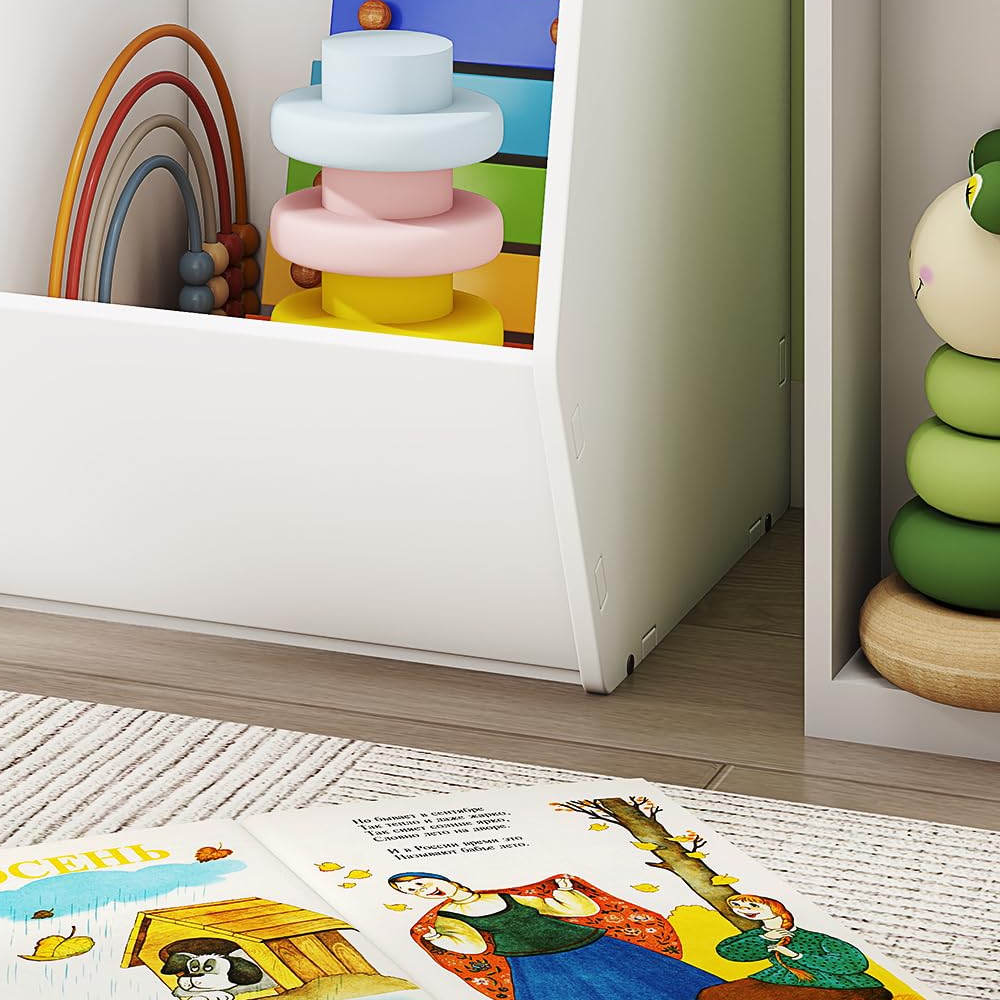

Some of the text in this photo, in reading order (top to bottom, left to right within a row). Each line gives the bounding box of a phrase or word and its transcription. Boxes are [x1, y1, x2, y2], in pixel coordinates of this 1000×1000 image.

[374, 813, 416, 822] бывает
[430, 807, 485, 816] сентябре
[385, 820, 421, 828] тепло
[436, 815, 466, 823] даже
[392, 826, 426, 834] сияет
[429, 821, 473, 830] солнце
[373, 833, 420, 842] Словно
[413, 842, 459, 851] России
[462, 838, 500, 847] время
[394, 849, 457, 861] Называют
[460, 845, 496, 853] бабье
